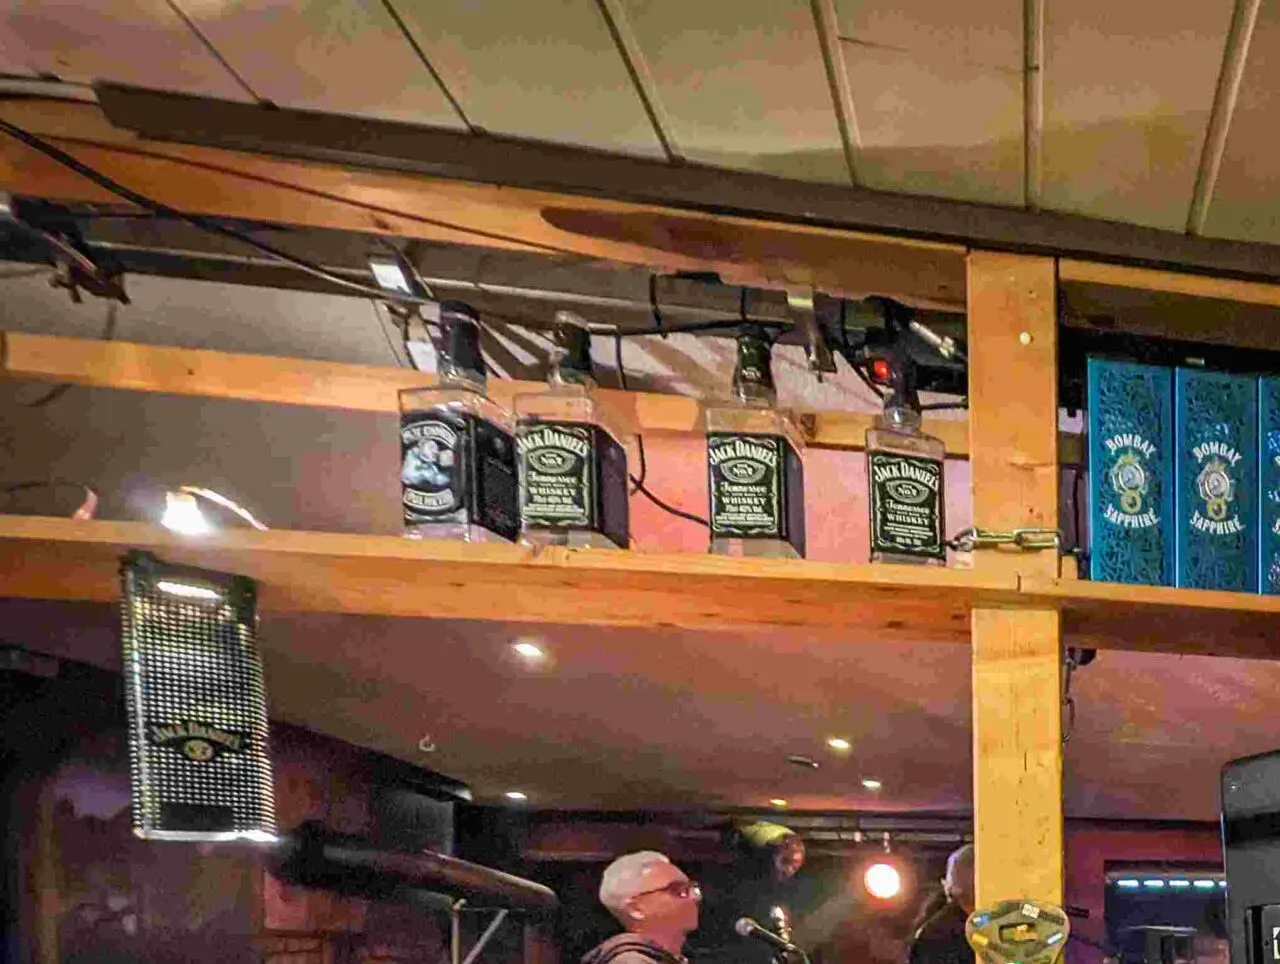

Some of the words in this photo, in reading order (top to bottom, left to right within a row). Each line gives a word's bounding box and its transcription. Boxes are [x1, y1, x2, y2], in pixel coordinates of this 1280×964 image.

[517, 431, 545, 454] JACK
[708, 444, 736, 465] JACK
[735, 440, 777, 467] DANIEL'S
[1106, 434, 1156, 458] BOMBAY
[1193, 441, 1243, 466] BOMBAY
[873, 465, 900, 482] JACK
[721, 496, 767, 505] WHISKEY
[887, 513, 929, 526] WHISKEY
[1104, 503, 1160, 528] SAPPHIRE
[1190, 510, 1245, 534] SAPPHIRE
